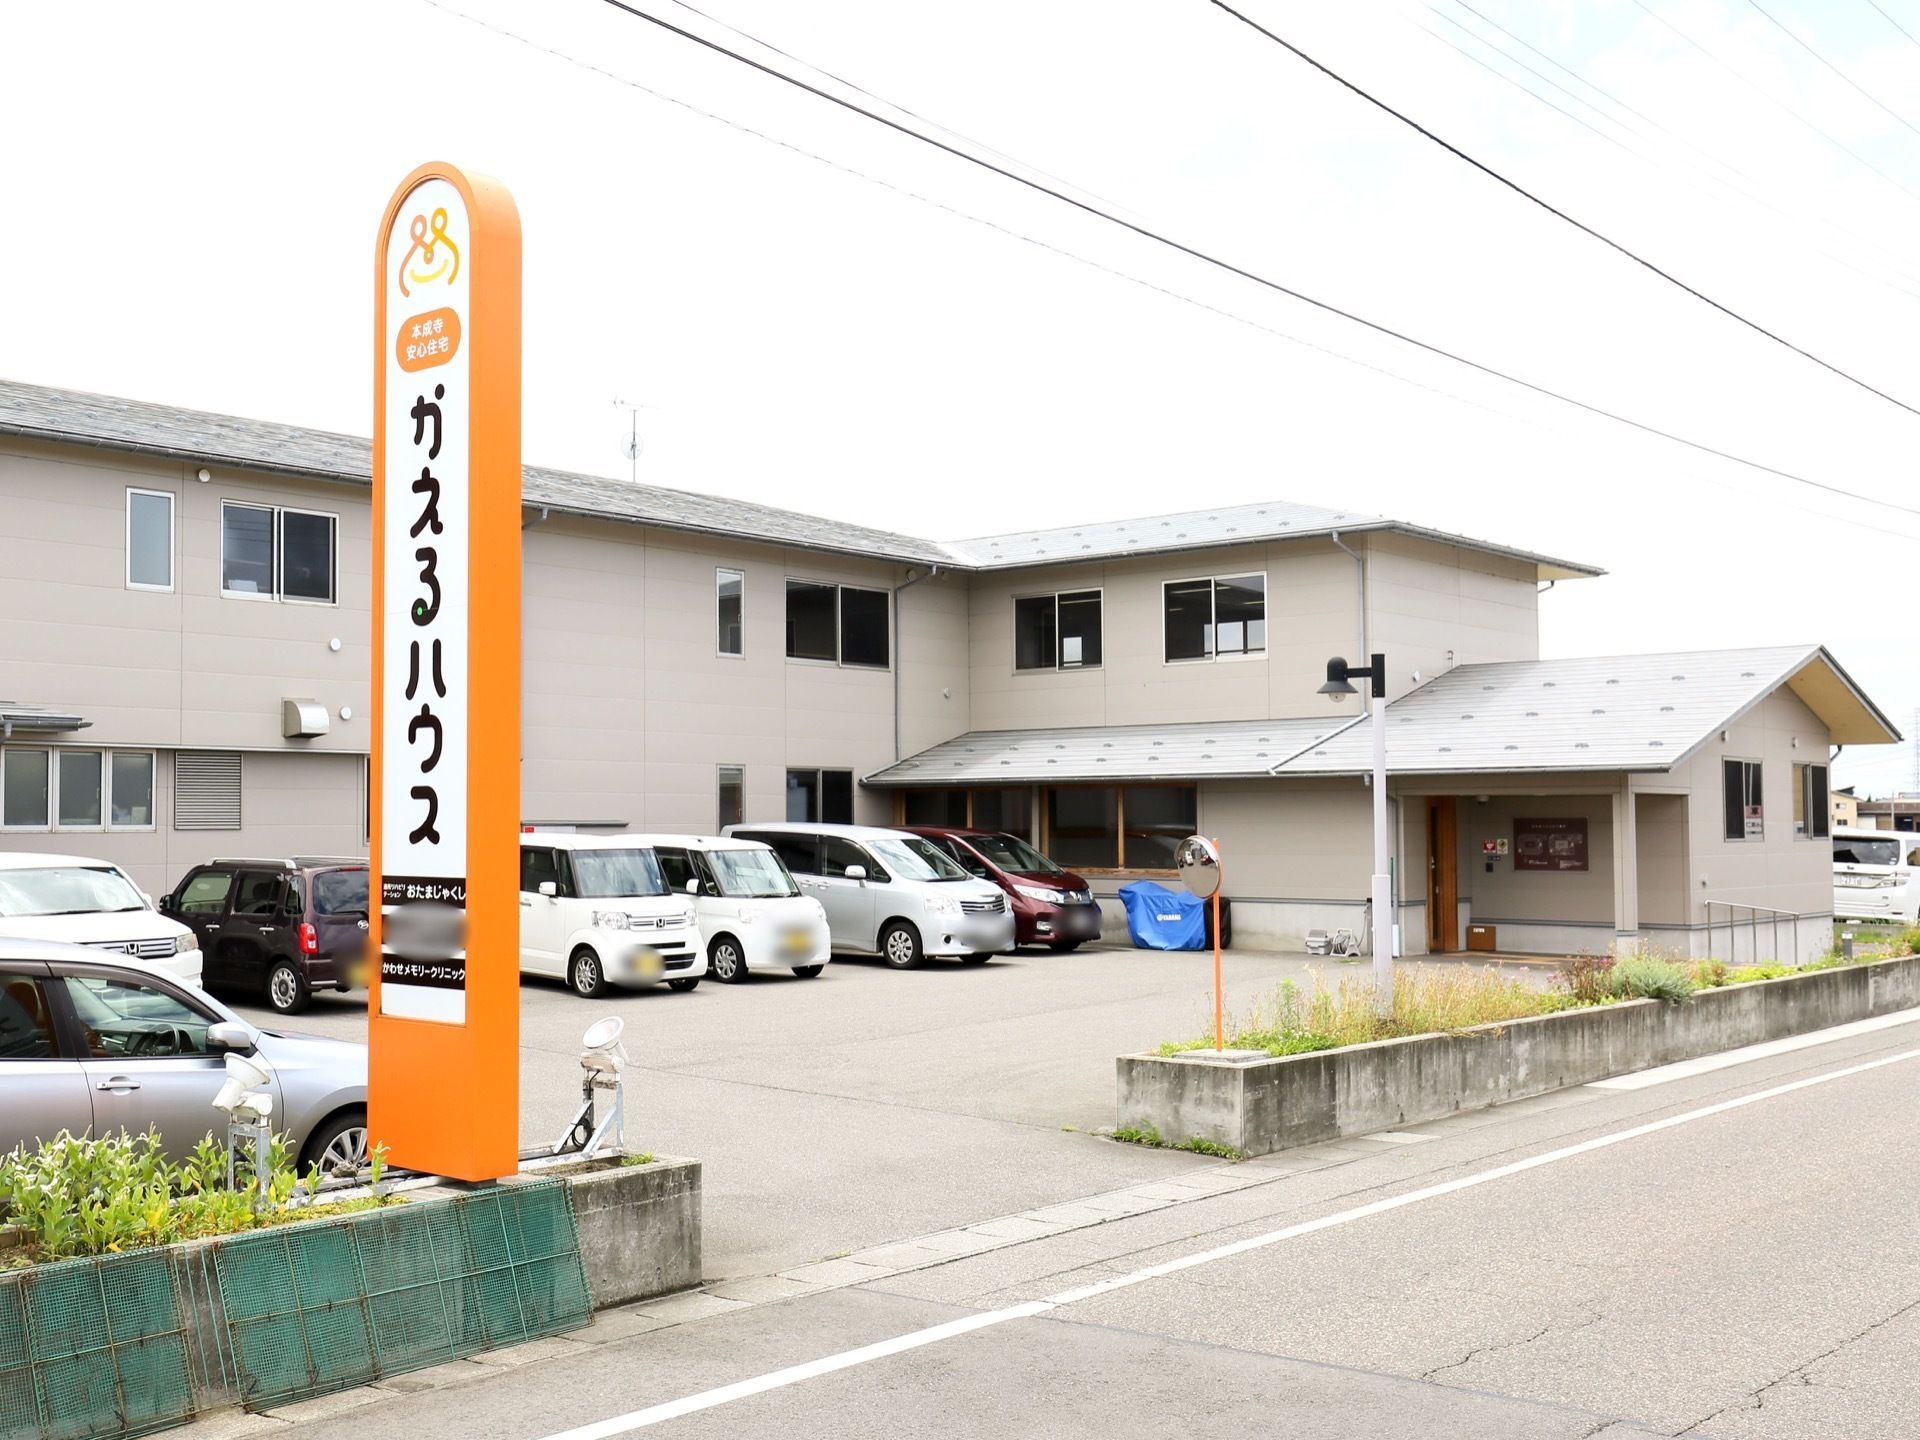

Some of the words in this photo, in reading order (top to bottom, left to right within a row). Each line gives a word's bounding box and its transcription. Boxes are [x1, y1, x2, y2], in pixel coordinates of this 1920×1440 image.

[411, 318, 443, 339] 本成寺
[406, 337, 449, 361] 安心住宅
[406, 884, 466, 900] おたまじゃくし
[382, 962, 466, 981] かわせメモリークリニック
